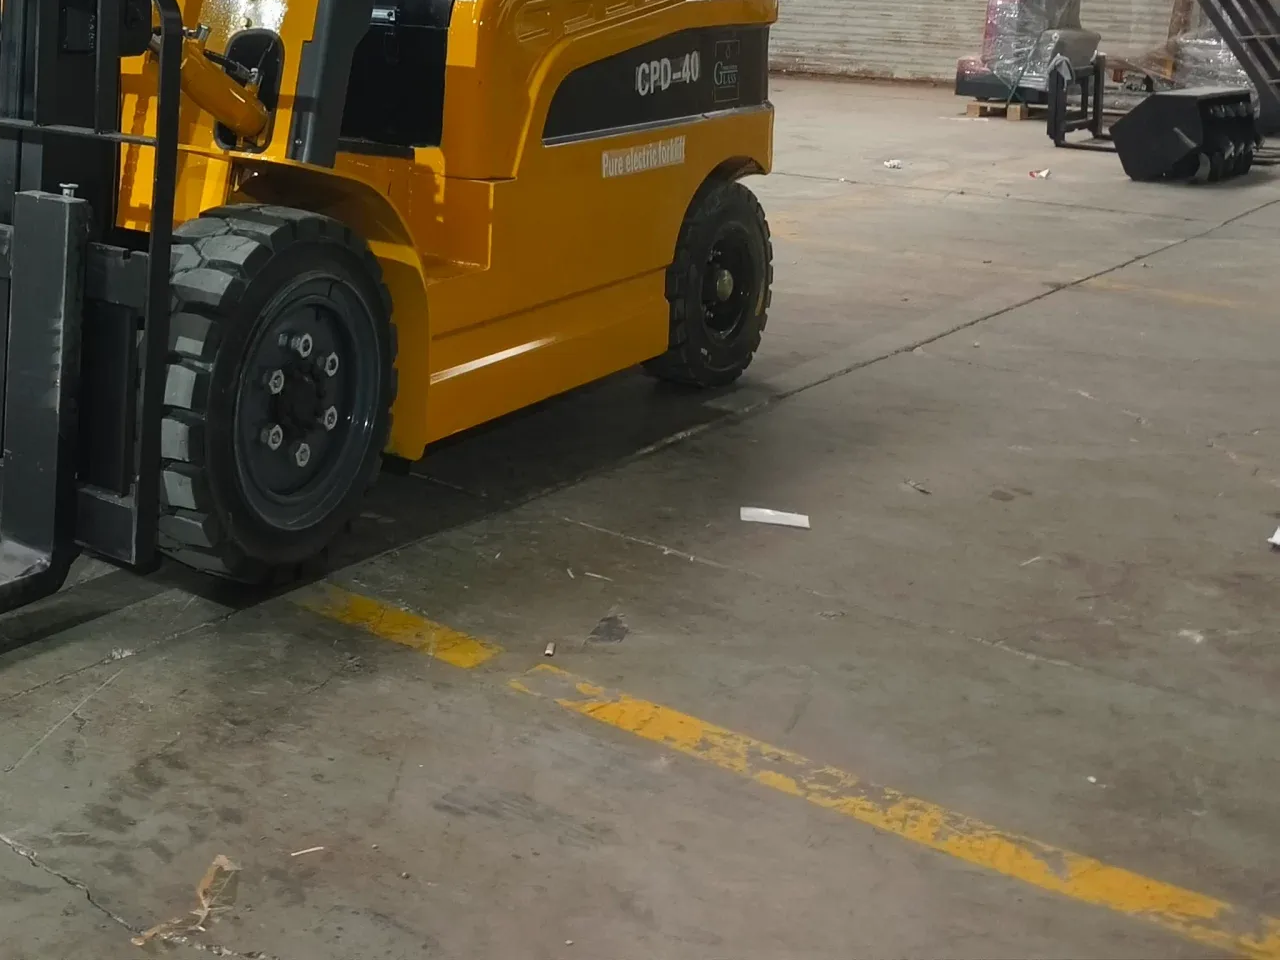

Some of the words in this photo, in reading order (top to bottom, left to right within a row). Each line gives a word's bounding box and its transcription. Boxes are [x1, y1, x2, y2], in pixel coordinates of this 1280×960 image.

[637, 50, 700, 97] CPD-40
[602, 151, 624, 178] Pure
[625, 143, 658, 173] electric
[658, 135, 686, 164] forklift
